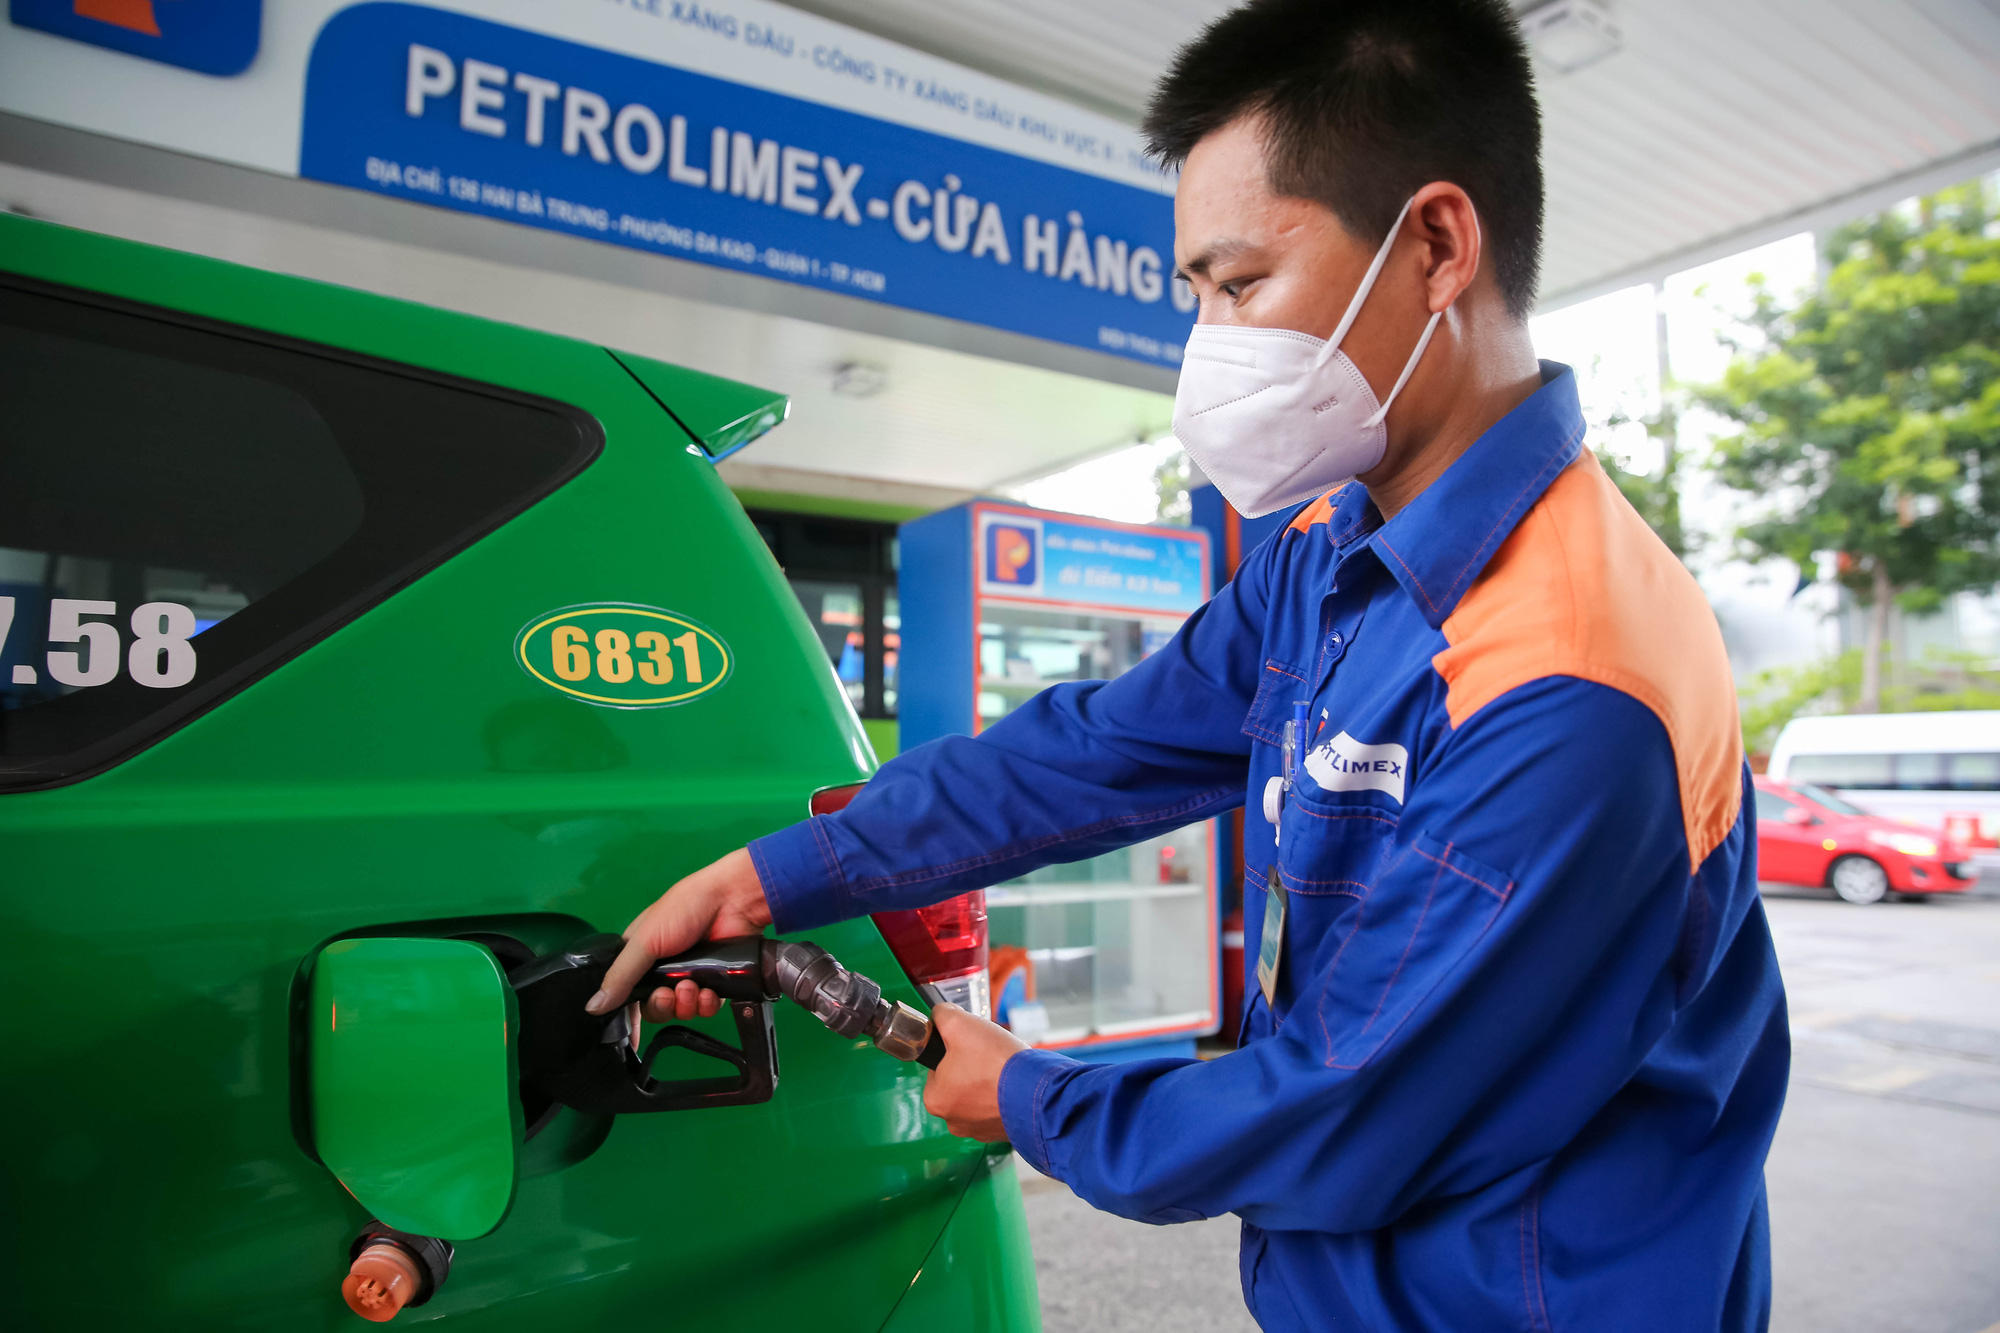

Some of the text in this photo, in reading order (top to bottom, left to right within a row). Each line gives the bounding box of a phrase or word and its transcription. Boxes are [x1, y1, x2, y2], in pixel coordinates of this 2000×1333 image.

[812, 44, 878, 84] CÔNG
[883, 63, 906, 91] TY
[1018, 113, 1059, 143] KHU
[481, 183, 516, 211] HAI
[517, 189, 545, 217] BÀ
[1023, 209, 1163, 303] HÀNG
[1311, 396, 1340, 416] N95
[551, 625, 703, 684] 6831
